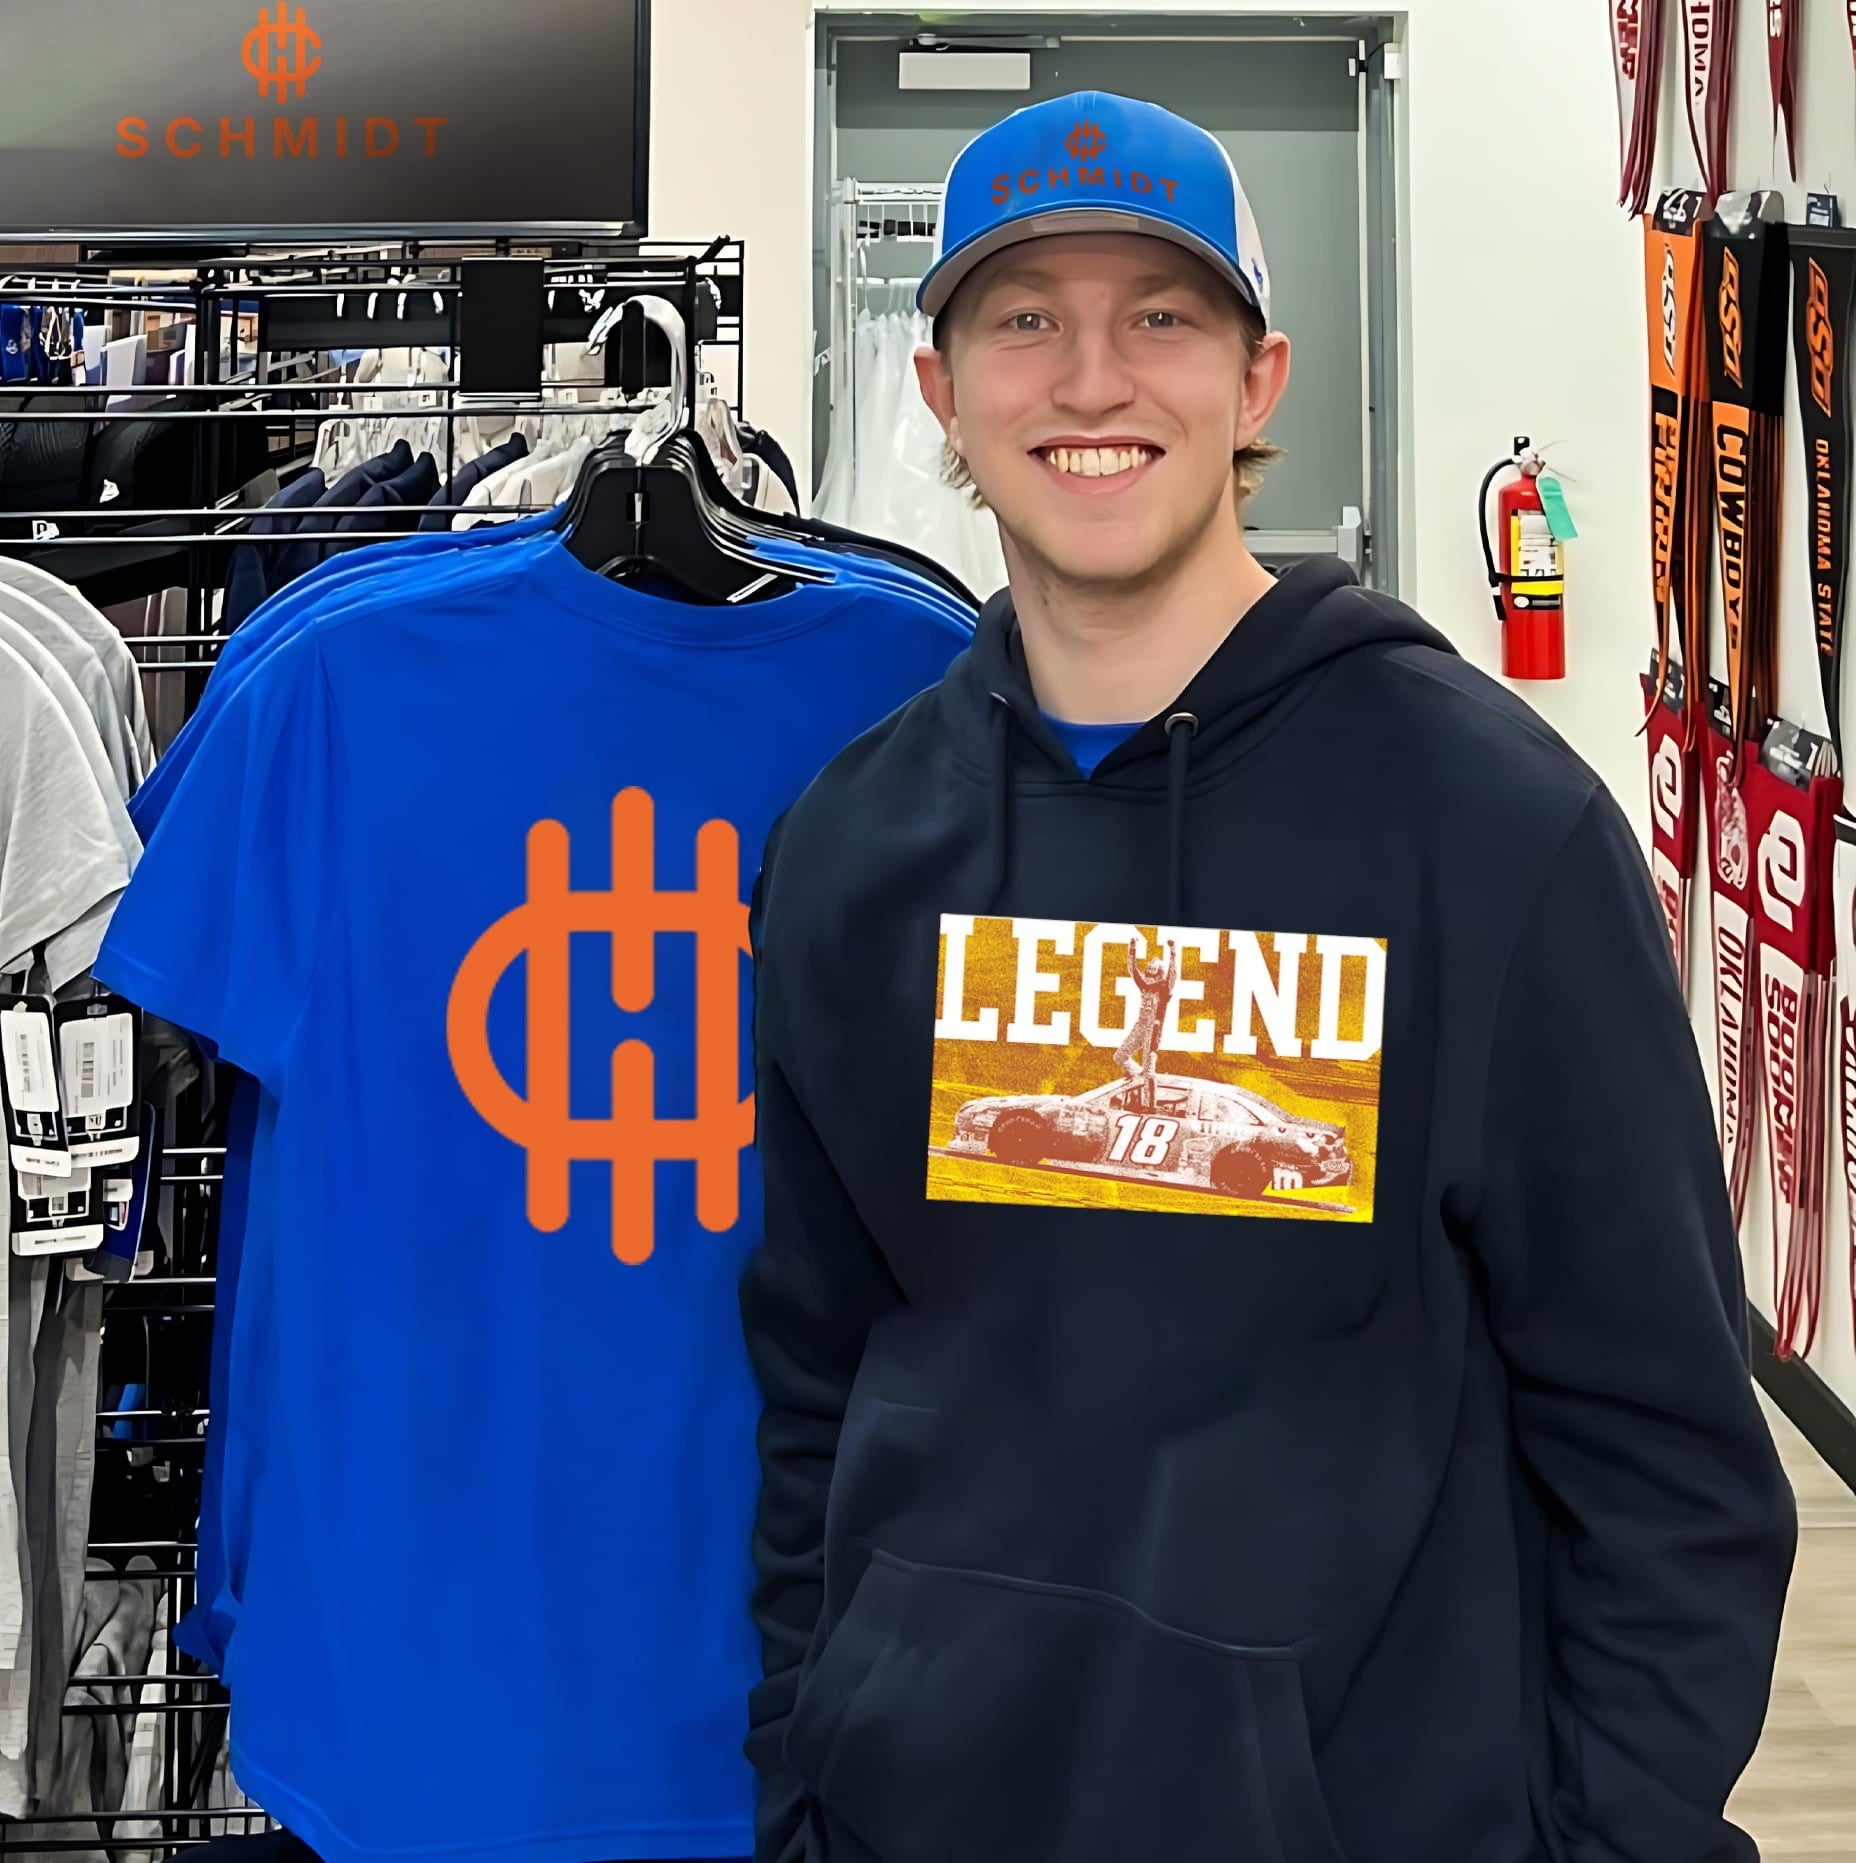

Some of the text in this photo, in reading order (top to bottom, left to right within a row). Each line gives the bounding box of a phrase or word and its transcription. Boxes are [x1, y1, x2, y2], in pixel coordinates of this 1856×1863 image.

[116, 116, 448, 159] SCHMIDT
[991, 167, 1180, 205] SCHMIDT
[1815, 438, 1834, 657] OKLAHOMA STATE
[935, 914, 1388, 1062] LEGEND
[1718, 926, 1745, 1145] OKLAHOMA
[1107, 1113, 1180, 1167] 18
